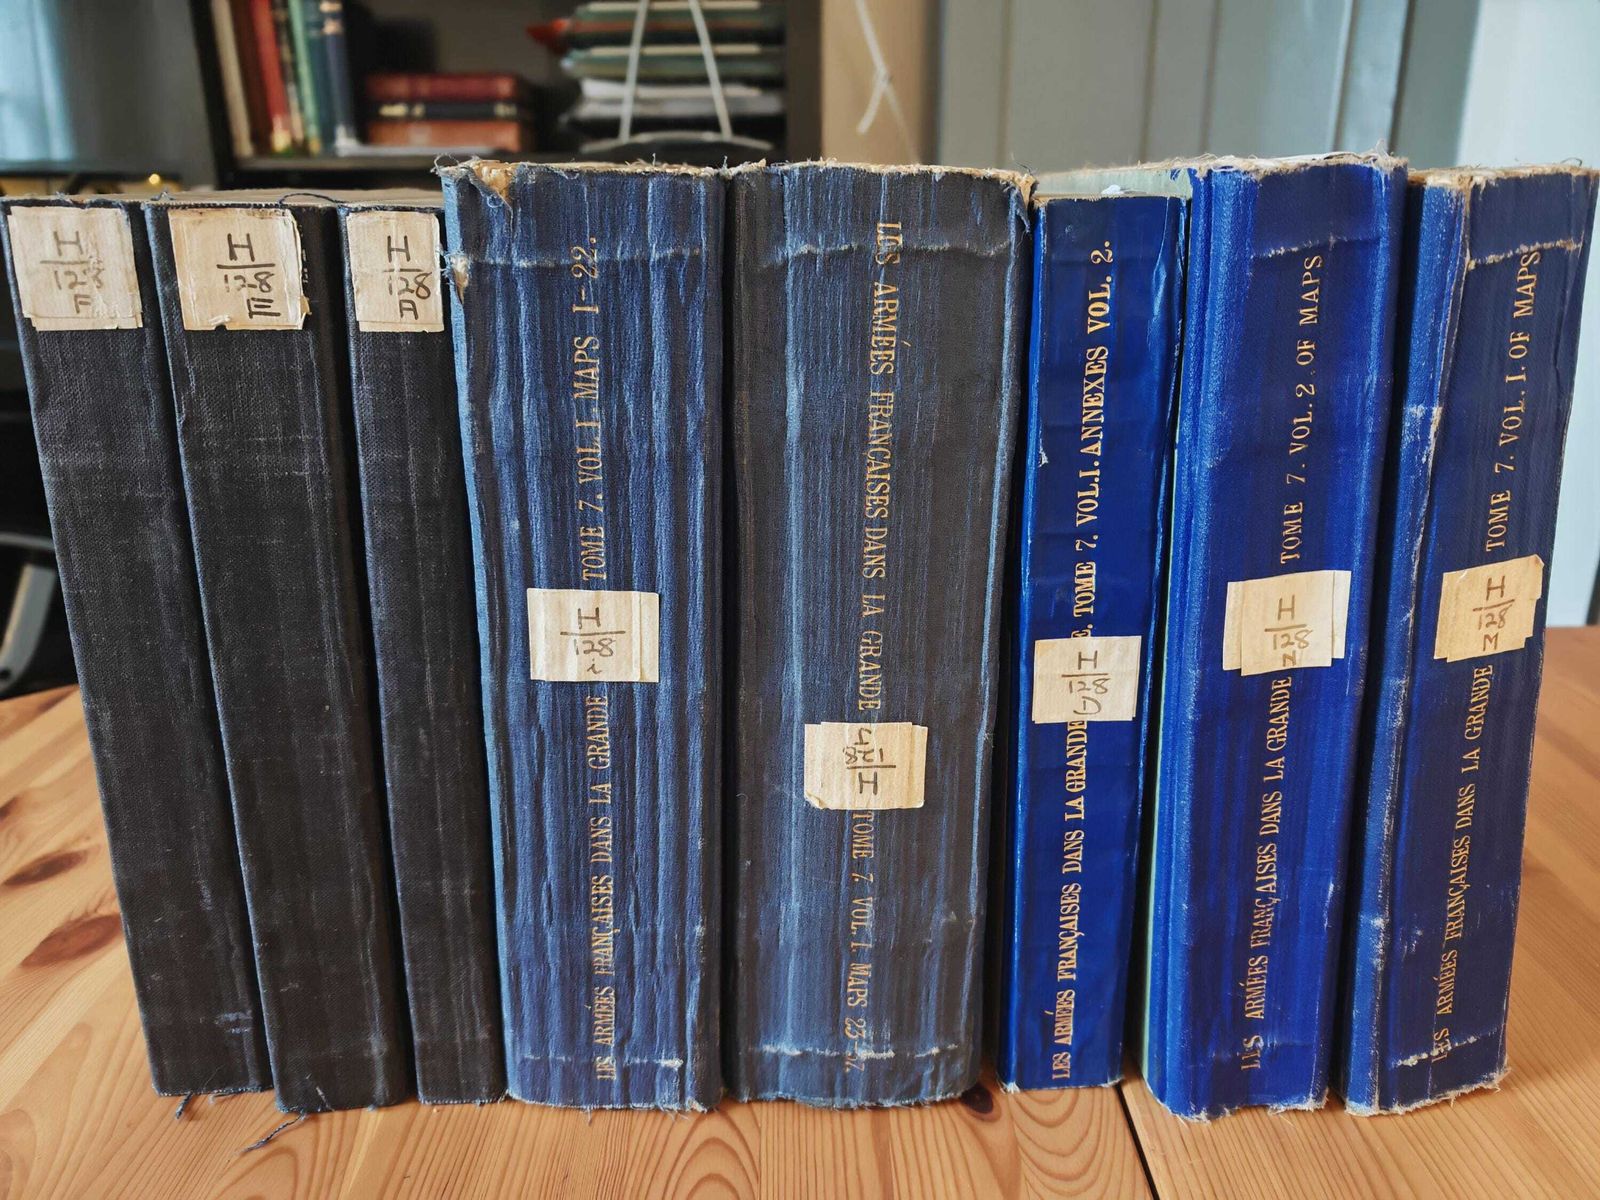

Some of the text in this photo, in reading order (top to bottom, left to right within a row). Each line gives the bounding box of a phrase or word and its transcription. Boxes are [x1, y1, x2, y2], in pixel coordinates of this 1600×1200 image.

[53, 231, 84, 257] H
[227, 233, 255, 262] H
[387, 235, 411, 263] H
[1090, 240, 1114, 264] 2.
[224, 271, 275, 293] 128
[388, 271, 432, 299] 128
[1297, 255, 1322, 327] MAPS
[1513, 251, 1542, 319] MAPS
[399, 299, 419, 320] A
[1087, 275, 1112, 335] VOL.
[870, 281, 912, 375] ARMÉES
[1508, 331, 1530, 360] OF
[573, 336, 600, 400] MAPS
[1296, 340, 1316, 366] OF
[1080, 346, 1109, 456] ANNEXES
[1498, 391, 1526, 447] VOL.
[1289, 403, 1313, 456] VOL.
[862, 390, 895, 518] FRANÇAISES
[1286, 463, 1306, 484] 7.
[1495, 455, 1515, 473] 7.
[575, 492, 604, 513] 7.
[1485, 490, 1511, 552] TOME
[580, 526, 607, 580] TOME
[861, 527, 888, 579] DANS
[1075, 534, 1099, 551] 7.
[1280, 501, 1303, 564] TOME
[861, 593, 886, 618] LA
[1073, 561, 1097, 617] TOME
[1277, 594, 1296, 620] H
[1486, 575, 1505, 602] H
[578, 607, 601, 630] H
[1273, 629, 1313, 650] 128
[1478, 604, 1513, 631] 128
[574, 637, 616, 657] 128
[1077, 650, 1098, 670] H
[1482, 632, 1499, 652] M
[858, 630, 883, 710] GRANDE
[1068, 678, 1111, 694] 128
[1265, 676, 1292, 752] GRANDE
[1464, 664, 1494, 741] GRANDE
[585, 695, 611, 770] GRANDE
[843, 745, 883, 766] 128
[1065, 720, 1088, 793] GRANDE
[1263, 756, 1286, 783] LA
[1461, 747, 1481, 774] LA
[587, 783, 611, 805] LA
[858, 771, 879, 796] H
[1455, 783, 1476, 829] DANS
[1064, 795, 1086, 821] LA
[1259, 790, 1283, 836] DANS
[589, 816, 612, 862] DANS
[852, 811, 875, 859] TOME
[1062, 829, 1085, 874] DANS
[1443, 835, 1472, 941] FRANÇAISES
[591, 875, 620, 976] FRANÇAISES
[851, 896, 875, 936] VOL.
[1056, 882, 1085, 982] FRANÇAISES
[847, 963, 872, 1008] MAPS
[1239, 955, 1269, 1020] ARMÉES
[1432, 950, 1458, 1016] ARMÉES
[584, 988, 615, 1046] ARMÉES
[1044, 989, 1076, 1046] ARMÉES
[1052, 1052, 1071, 1080] LES
